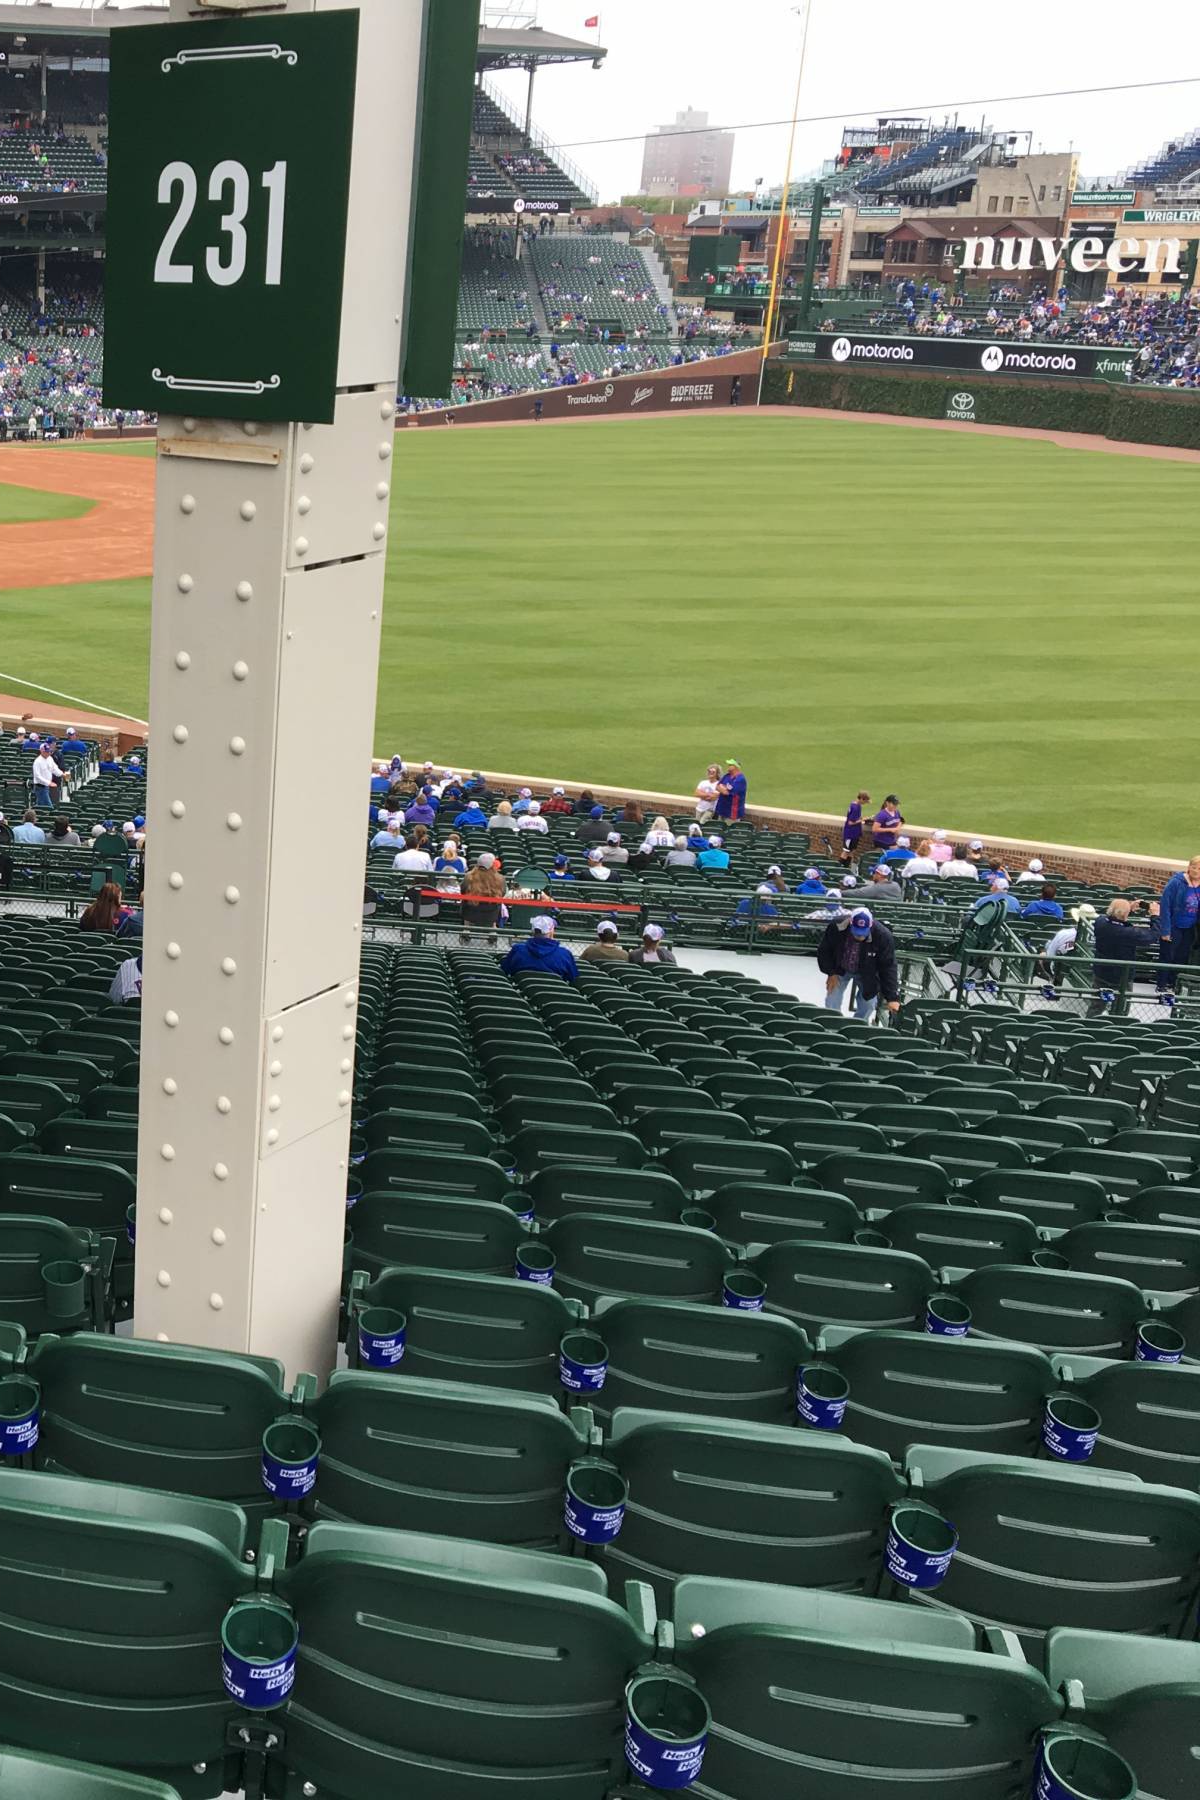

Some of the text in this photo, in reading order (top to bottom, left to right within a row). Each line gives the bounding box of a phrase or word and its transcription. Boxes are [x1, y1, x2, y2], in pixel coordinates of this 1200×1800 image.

[525, 201, 559, 210] motorola
[154, 160, 287, 286] 231
[960, 236, 1181, 273] nuveen
[852, 345, 914, 360] motorola
[1005, 352, 1076, 370] motorola
[566, 394, 608, 405] TransUnion
[946, 410, 975, 420] TOYOTA
[7, 1424, 31, 1433] Hefty
[281, 1469, 307, 1477] Hefty
[594, 1512, 619, 1521] Hefty
[890, 1562, 916, 1581] Hefty
[251, 1668, 284, 1678] Hefty
[665, 1749, 699, 1760] Hefty
